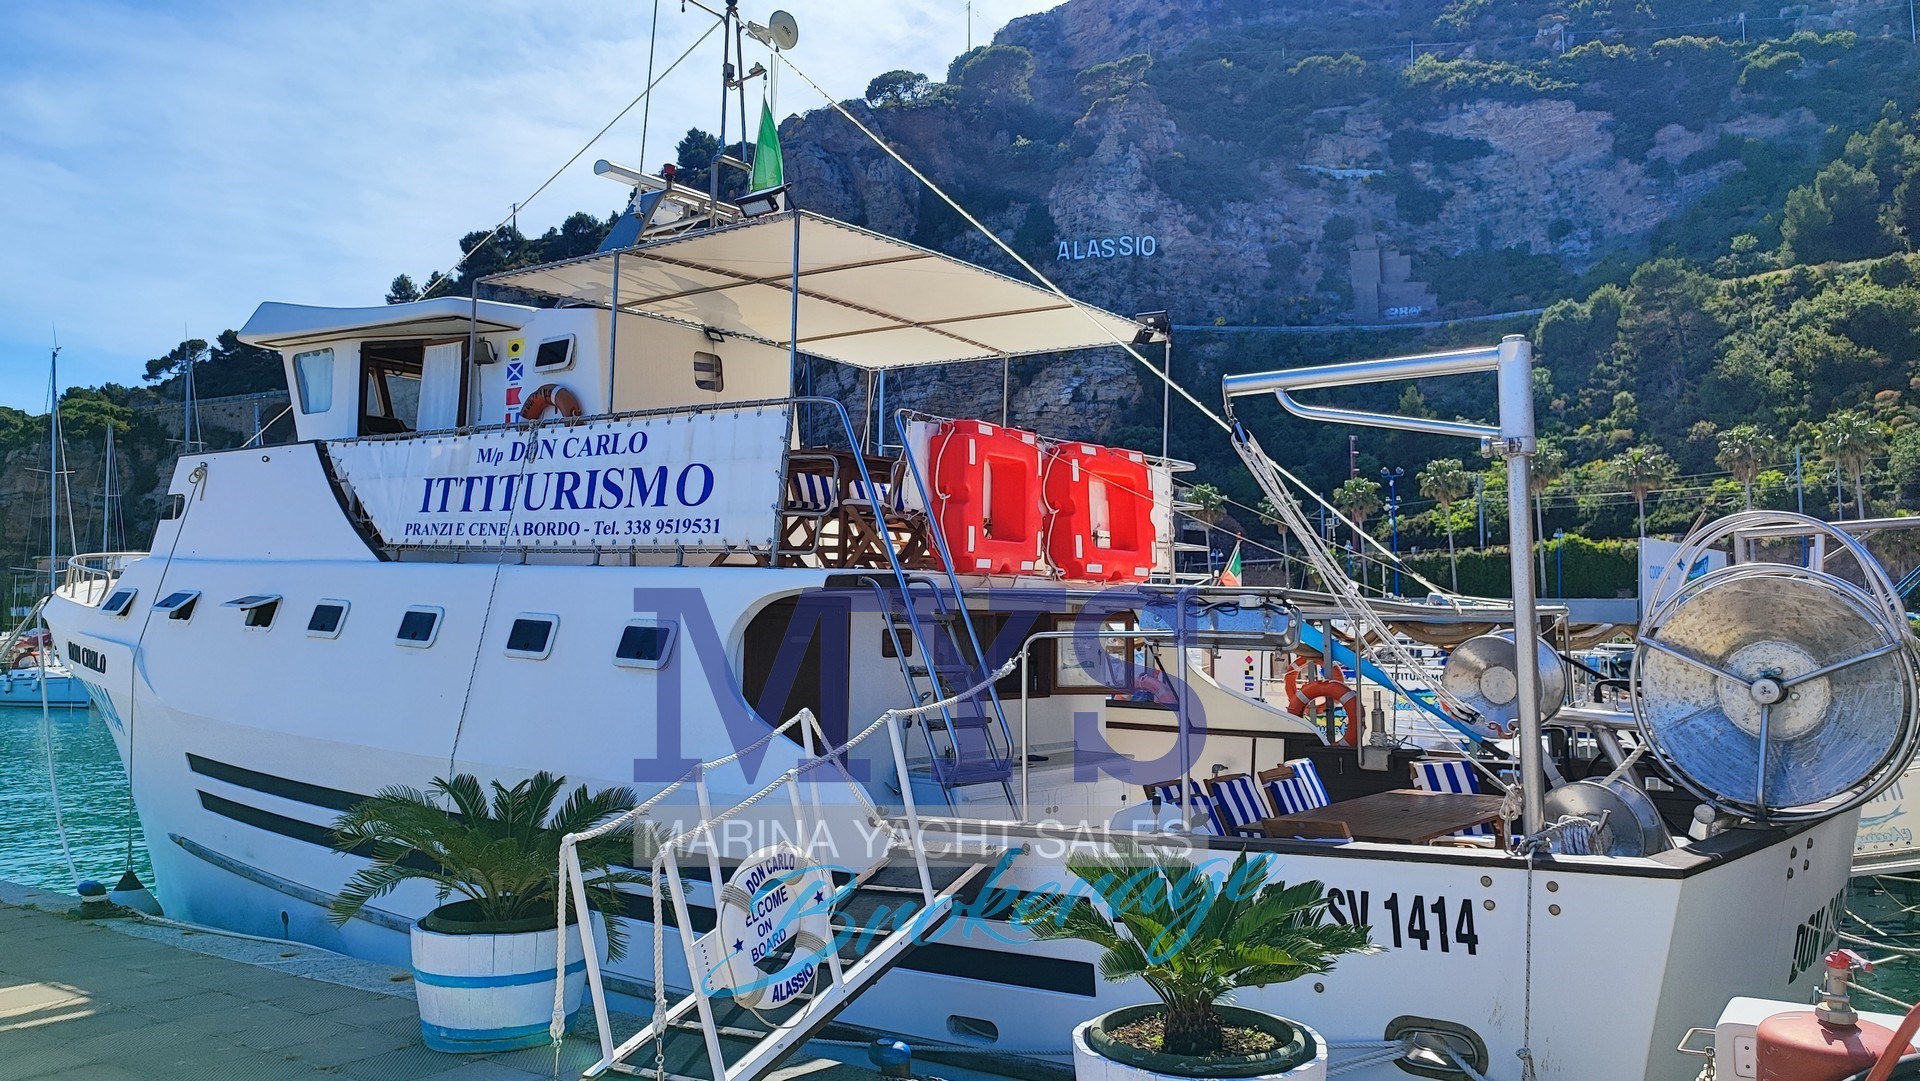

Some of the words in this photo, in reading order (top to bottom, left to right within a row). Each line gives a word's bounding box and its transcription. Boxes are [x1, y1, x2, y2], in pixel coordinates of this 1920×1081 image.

[1056, 235, 1156, 260] ALASSIO
[477, 447, 503, 466] M/p
[509, 441, 557, 462] DON
[562, 431, 648, 459] CARLO
[419, 462, 714, 513] ITTITURISMO
[404, 522, 453, 536] PRANZI
[455, 522, 465, 536] E
[468, 522, 507, 537] CENE
[510, 522, 520, 537] A
[523, 521, 580, 536] BORDO
[594, 520, 620, 535] Tel.
[624, 519, 651, 535] 338
[655, 518, 720, 534] 9519531
[82, 647, 106, 674] CARLO
[745, 867, 766, 895] DON
[766, 853, 795, 875] CARLO
[745, 885, 789, 928] ELCOME
[1384, 892, 1478, 955] 1414
[757, 917, 773, 937] ON
[751, 928, 787, 963] BOARD
[771, 962, 814, 1003] ALASSIO
